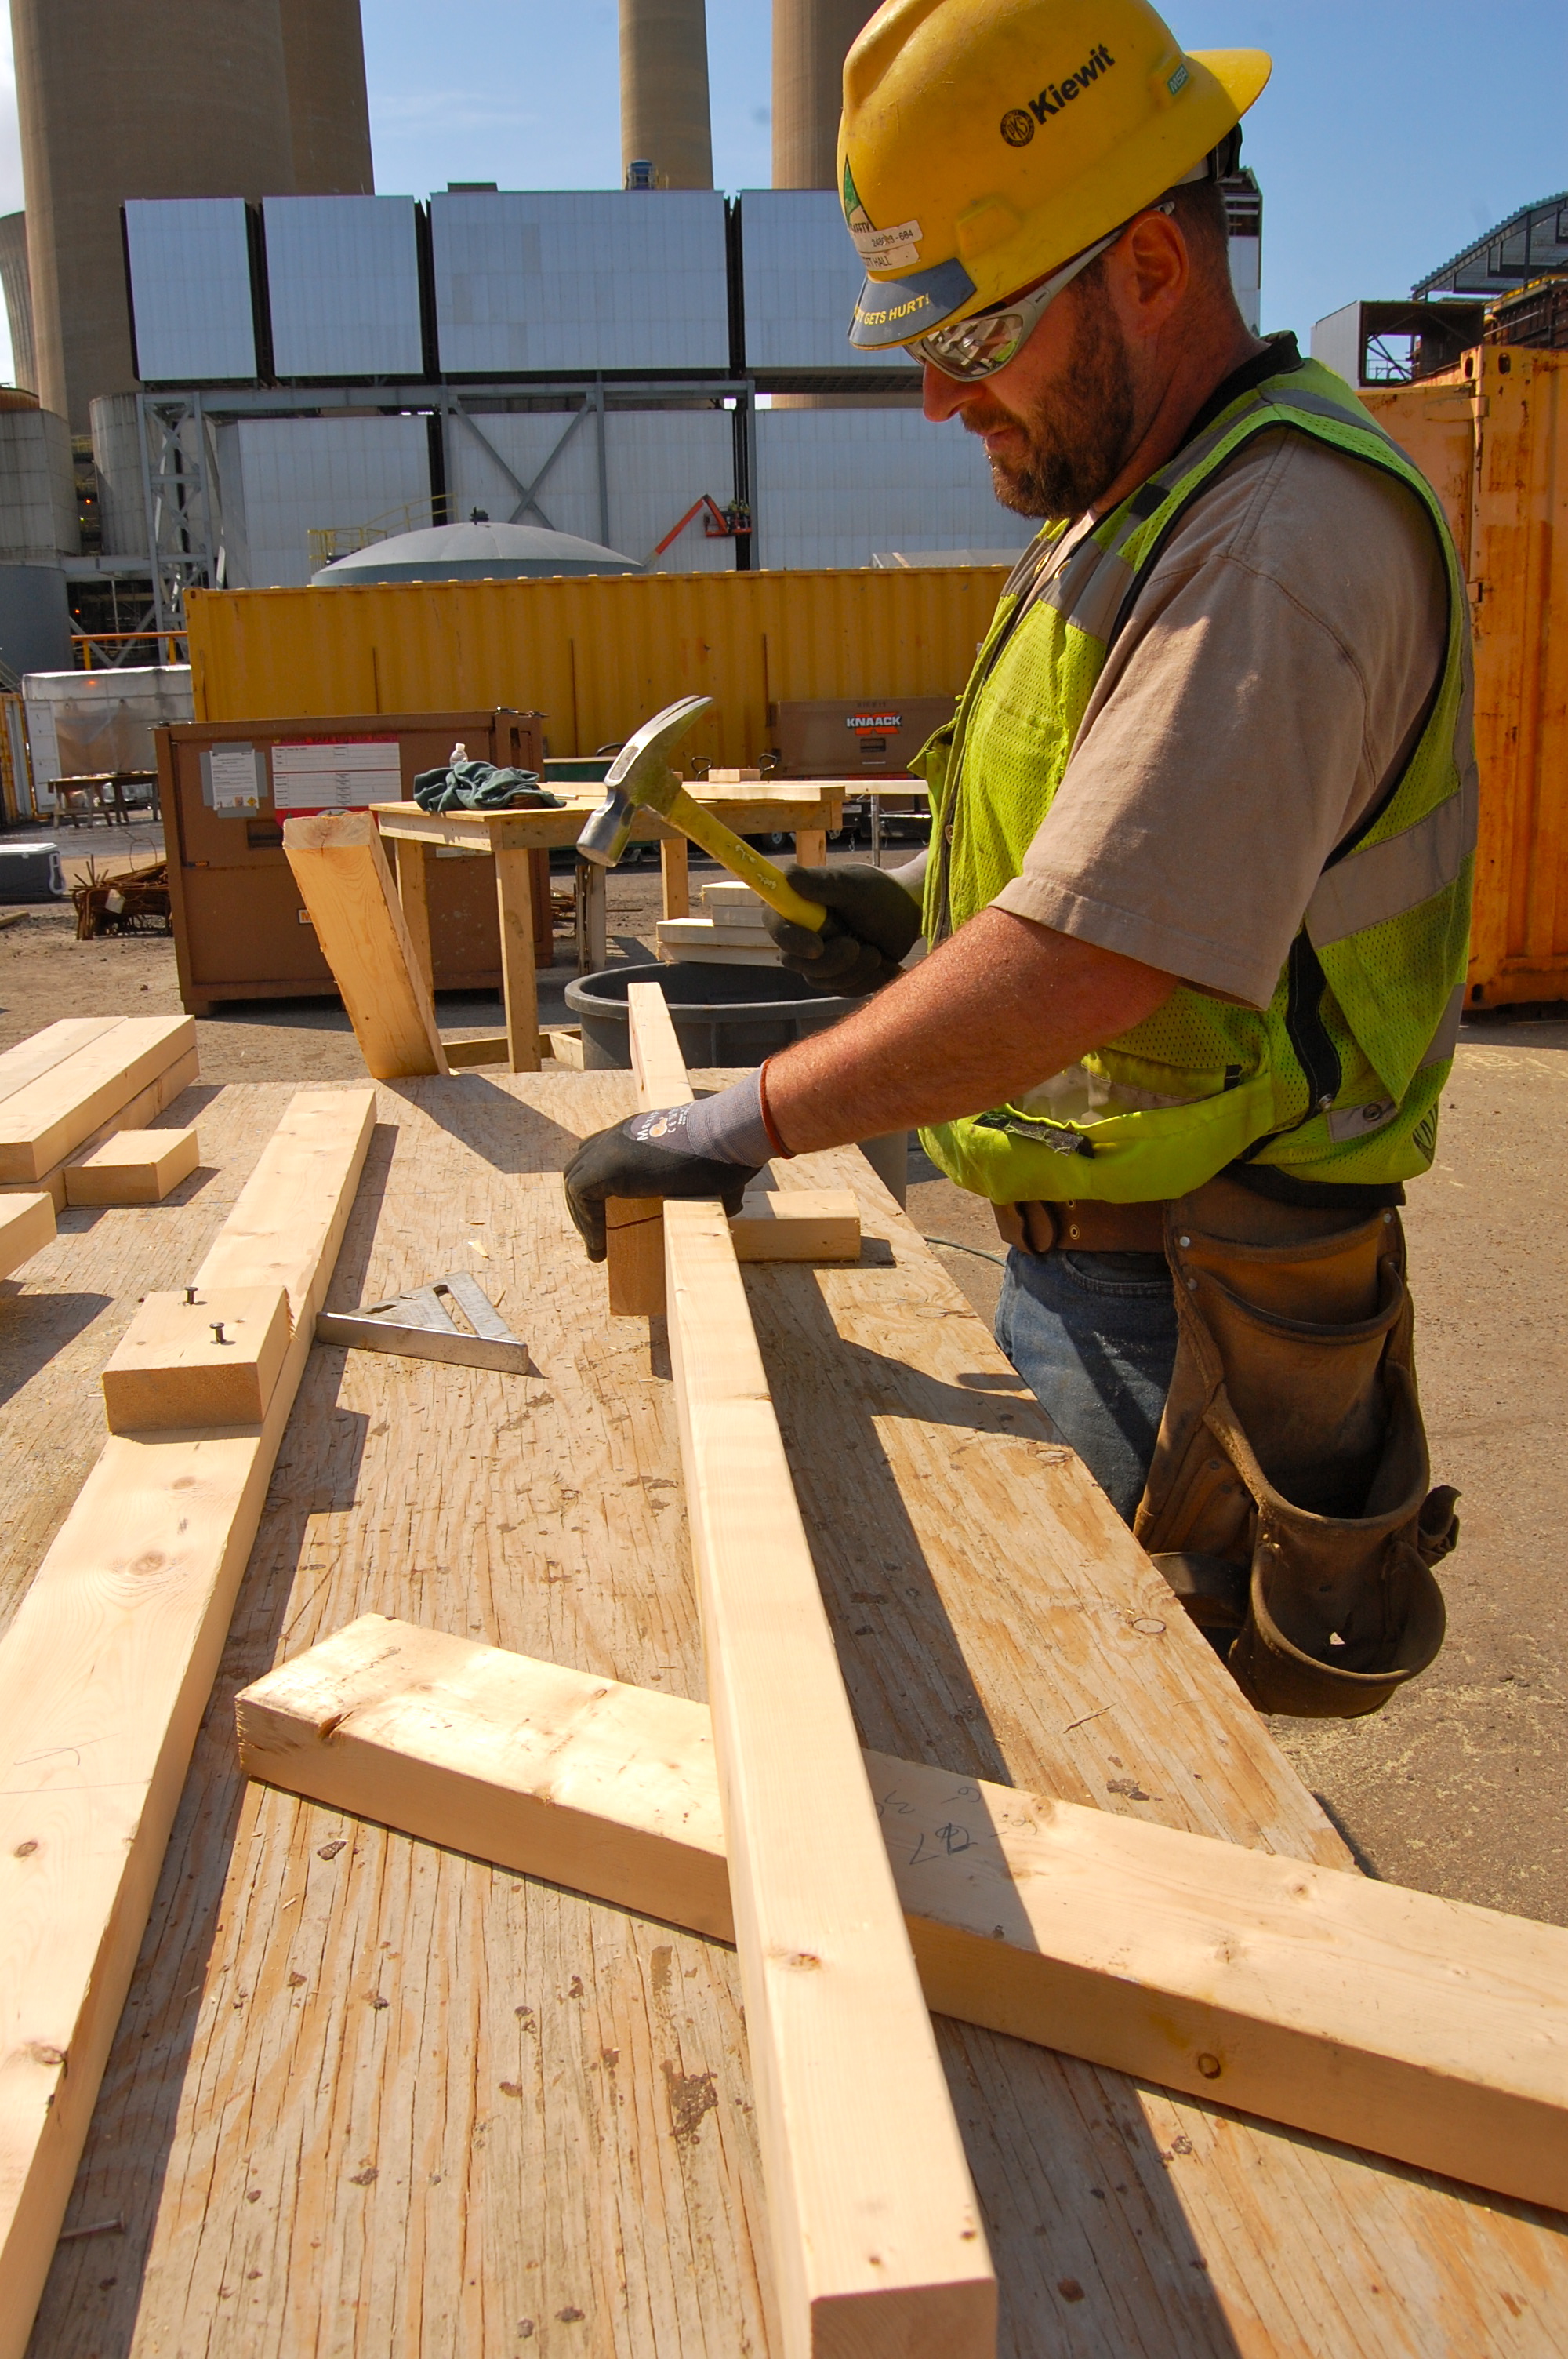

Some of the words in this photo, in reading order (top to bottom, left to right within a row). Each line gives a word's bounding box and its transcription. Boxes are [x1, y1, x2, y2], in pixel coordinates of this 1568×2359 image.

[1028, 43, 1116, 125] Kiewit
[872, 256, 892, 267] HALL
[864, 311, 887, 325] GETS
[888, 293, 930, 322] HURT!
[846, 716, 902, 728] KNAACK
